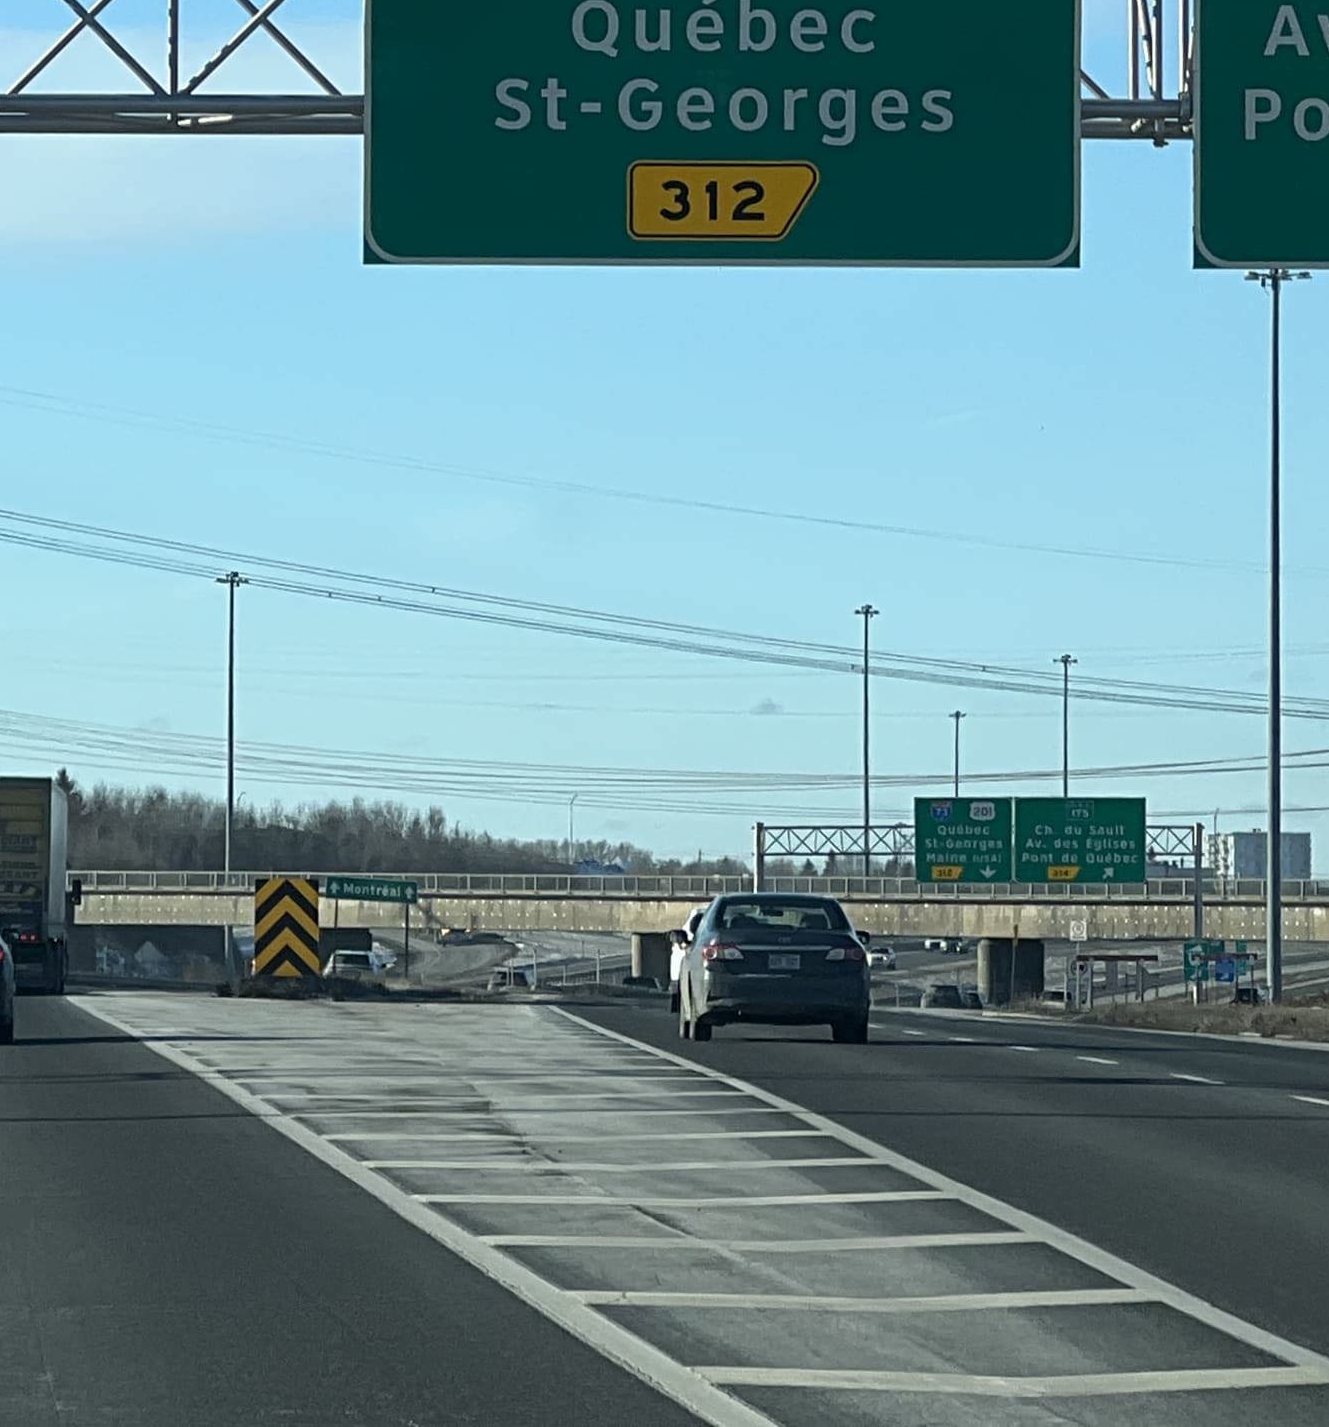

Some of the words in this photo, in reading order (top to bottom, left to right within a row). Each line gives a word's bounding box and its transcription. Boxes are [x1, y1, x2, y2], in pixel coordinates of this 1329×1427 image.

[495, 78, 953, 146] St-Georges
[659, 179, 765, 222] 312
[973, 806, 993, 817] 201
[1071, 809, 1089, 818] 175
[937, 825, 990, 835] Québec
[1064, 825, 1082, 835] du
[1089, 824, 1124, 835] Sault
[925, 838, 1003, 851] St-Georges
[1054, 838, 1079, 849] des
[926, 853, 967, 863] Maine
[1021, 853, 1053, 863] Pont
[1061, 853, 1078, 863] de
[1086, 852, 1138, 864] Québec
[343, 882, 401, 897] Montréal
